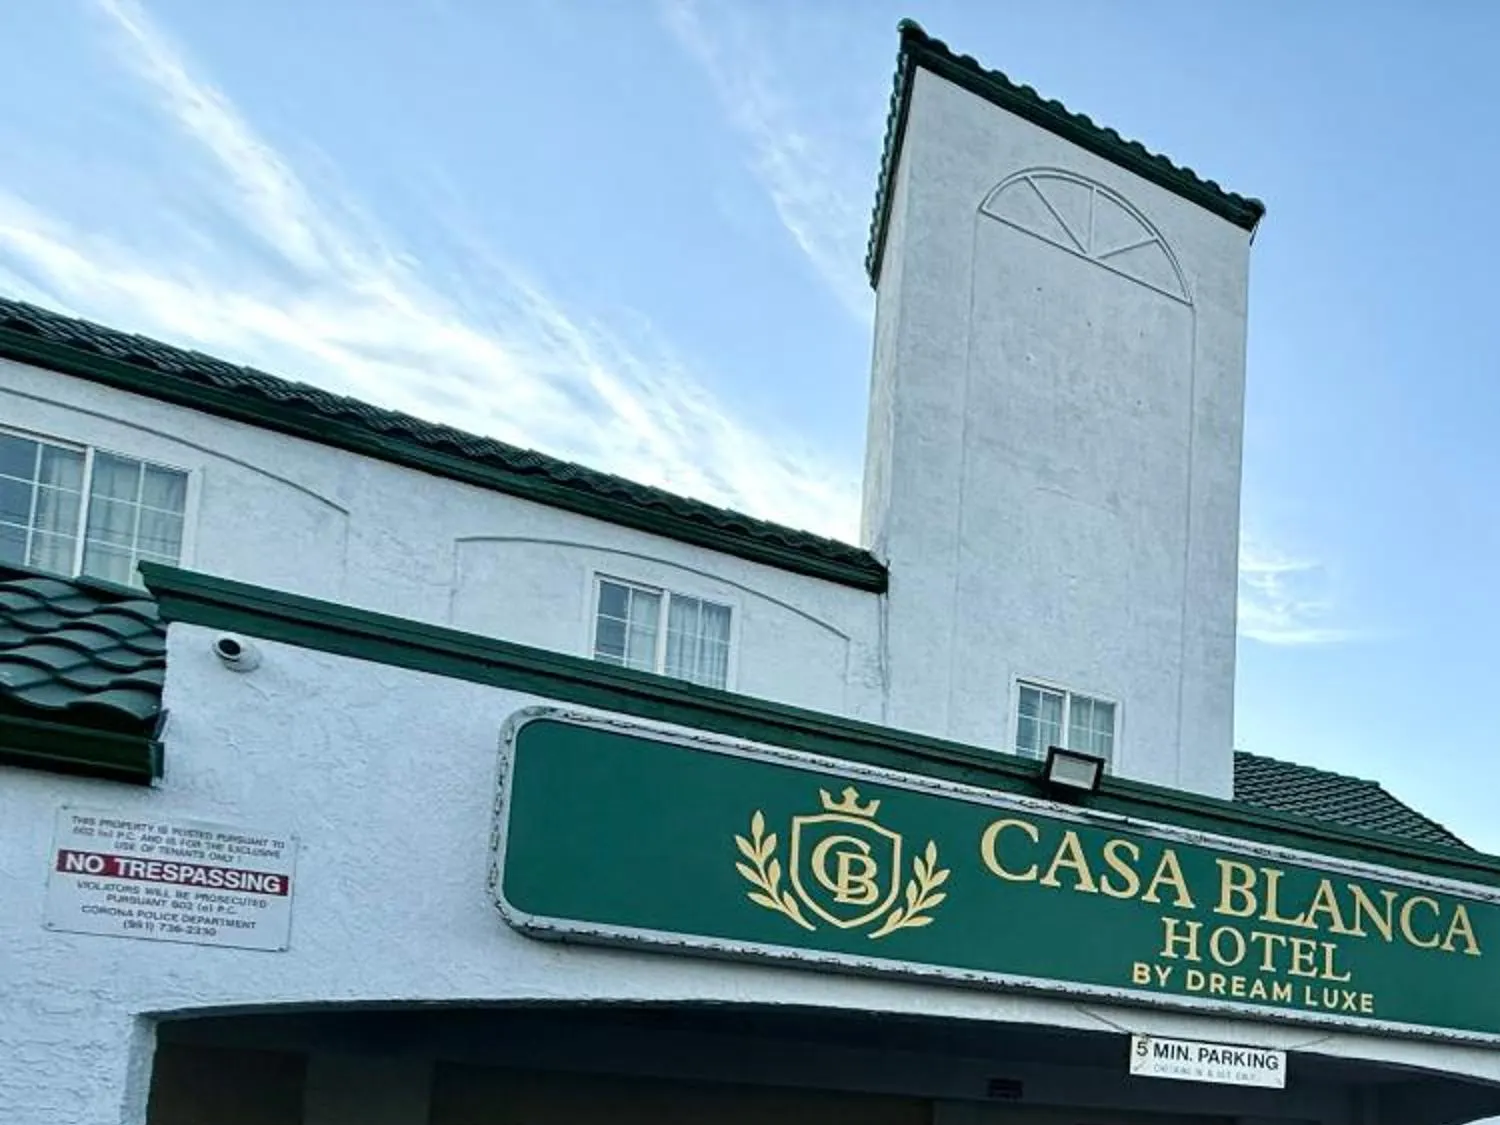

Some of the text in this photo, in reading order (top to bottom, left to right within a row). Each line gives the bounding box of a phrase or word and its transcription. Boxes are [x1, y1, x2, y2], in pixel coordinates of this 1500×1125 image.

[64, 852, 281, 893] NO TRESPASSING
[77, 880, 141, 895] VIOLATORS
[979, 817, 1483, 956] CASA BLANCA
[137, 908, 179, 921] POLICE
[181, 912, 257, 929] DEPARTMENT
[1158, 916, 1352, 983] HOTEL
[1132, 961, 1375, 1014] BY DREAM LUXE
[1136, 1041, 1280, 1071] 5 MIN. PARKING
